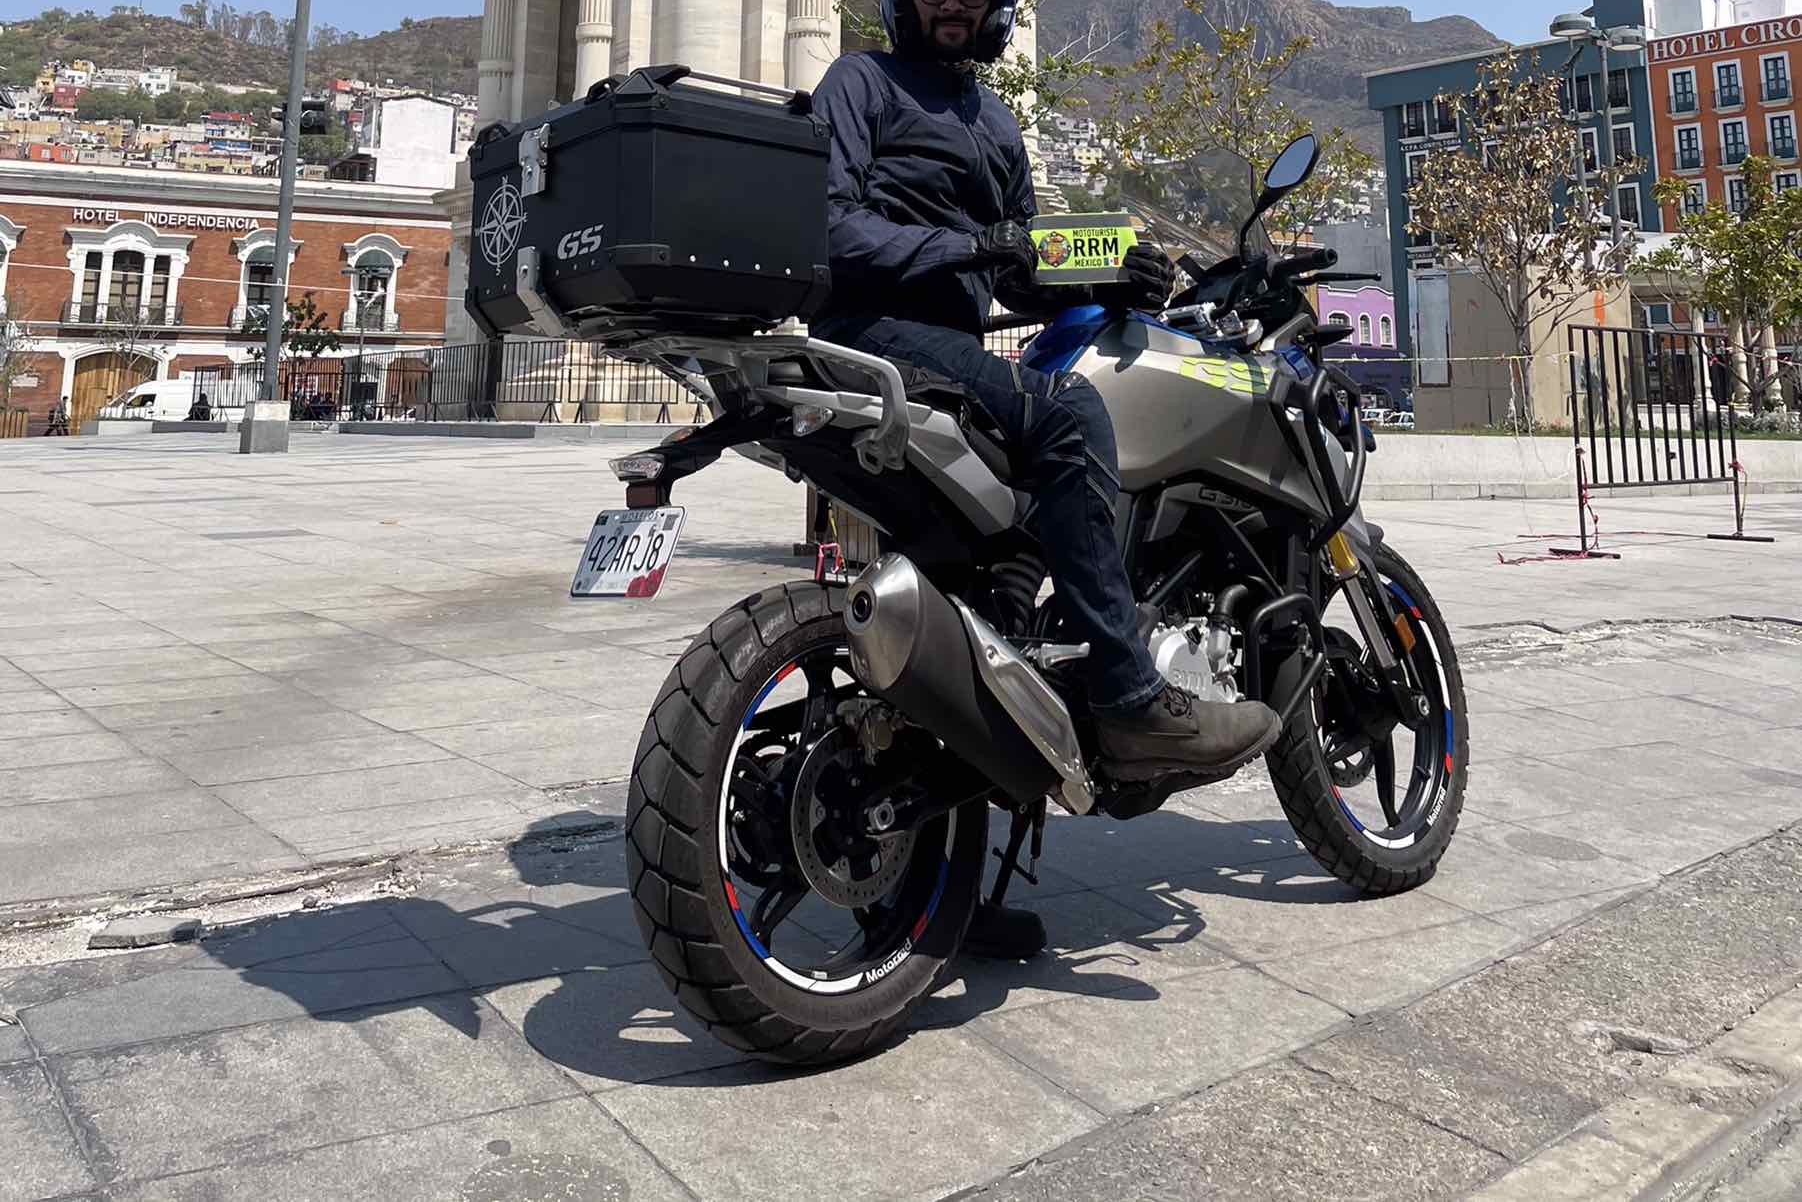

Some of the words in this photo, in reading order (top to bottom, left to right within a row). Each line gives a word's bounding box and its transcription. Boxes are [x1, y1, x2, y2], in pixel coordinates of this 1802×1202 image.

[1652, 29, 1736, 61] HOTEL
[1740, 17, 1802, 46] CIRO
[73, 208, 124, 222] HOTEL
[143, 211, 260, 230] INDEPENDENCIA
[1072, 228, 1119, 237] MOTOTURISTA
[557, 224, 604, 260] GS
[1073, 238, 1119, 257] RRM
[588, 532, 665, 574] 42ARJ8
[865, 936, 913, 984] Motorrad
